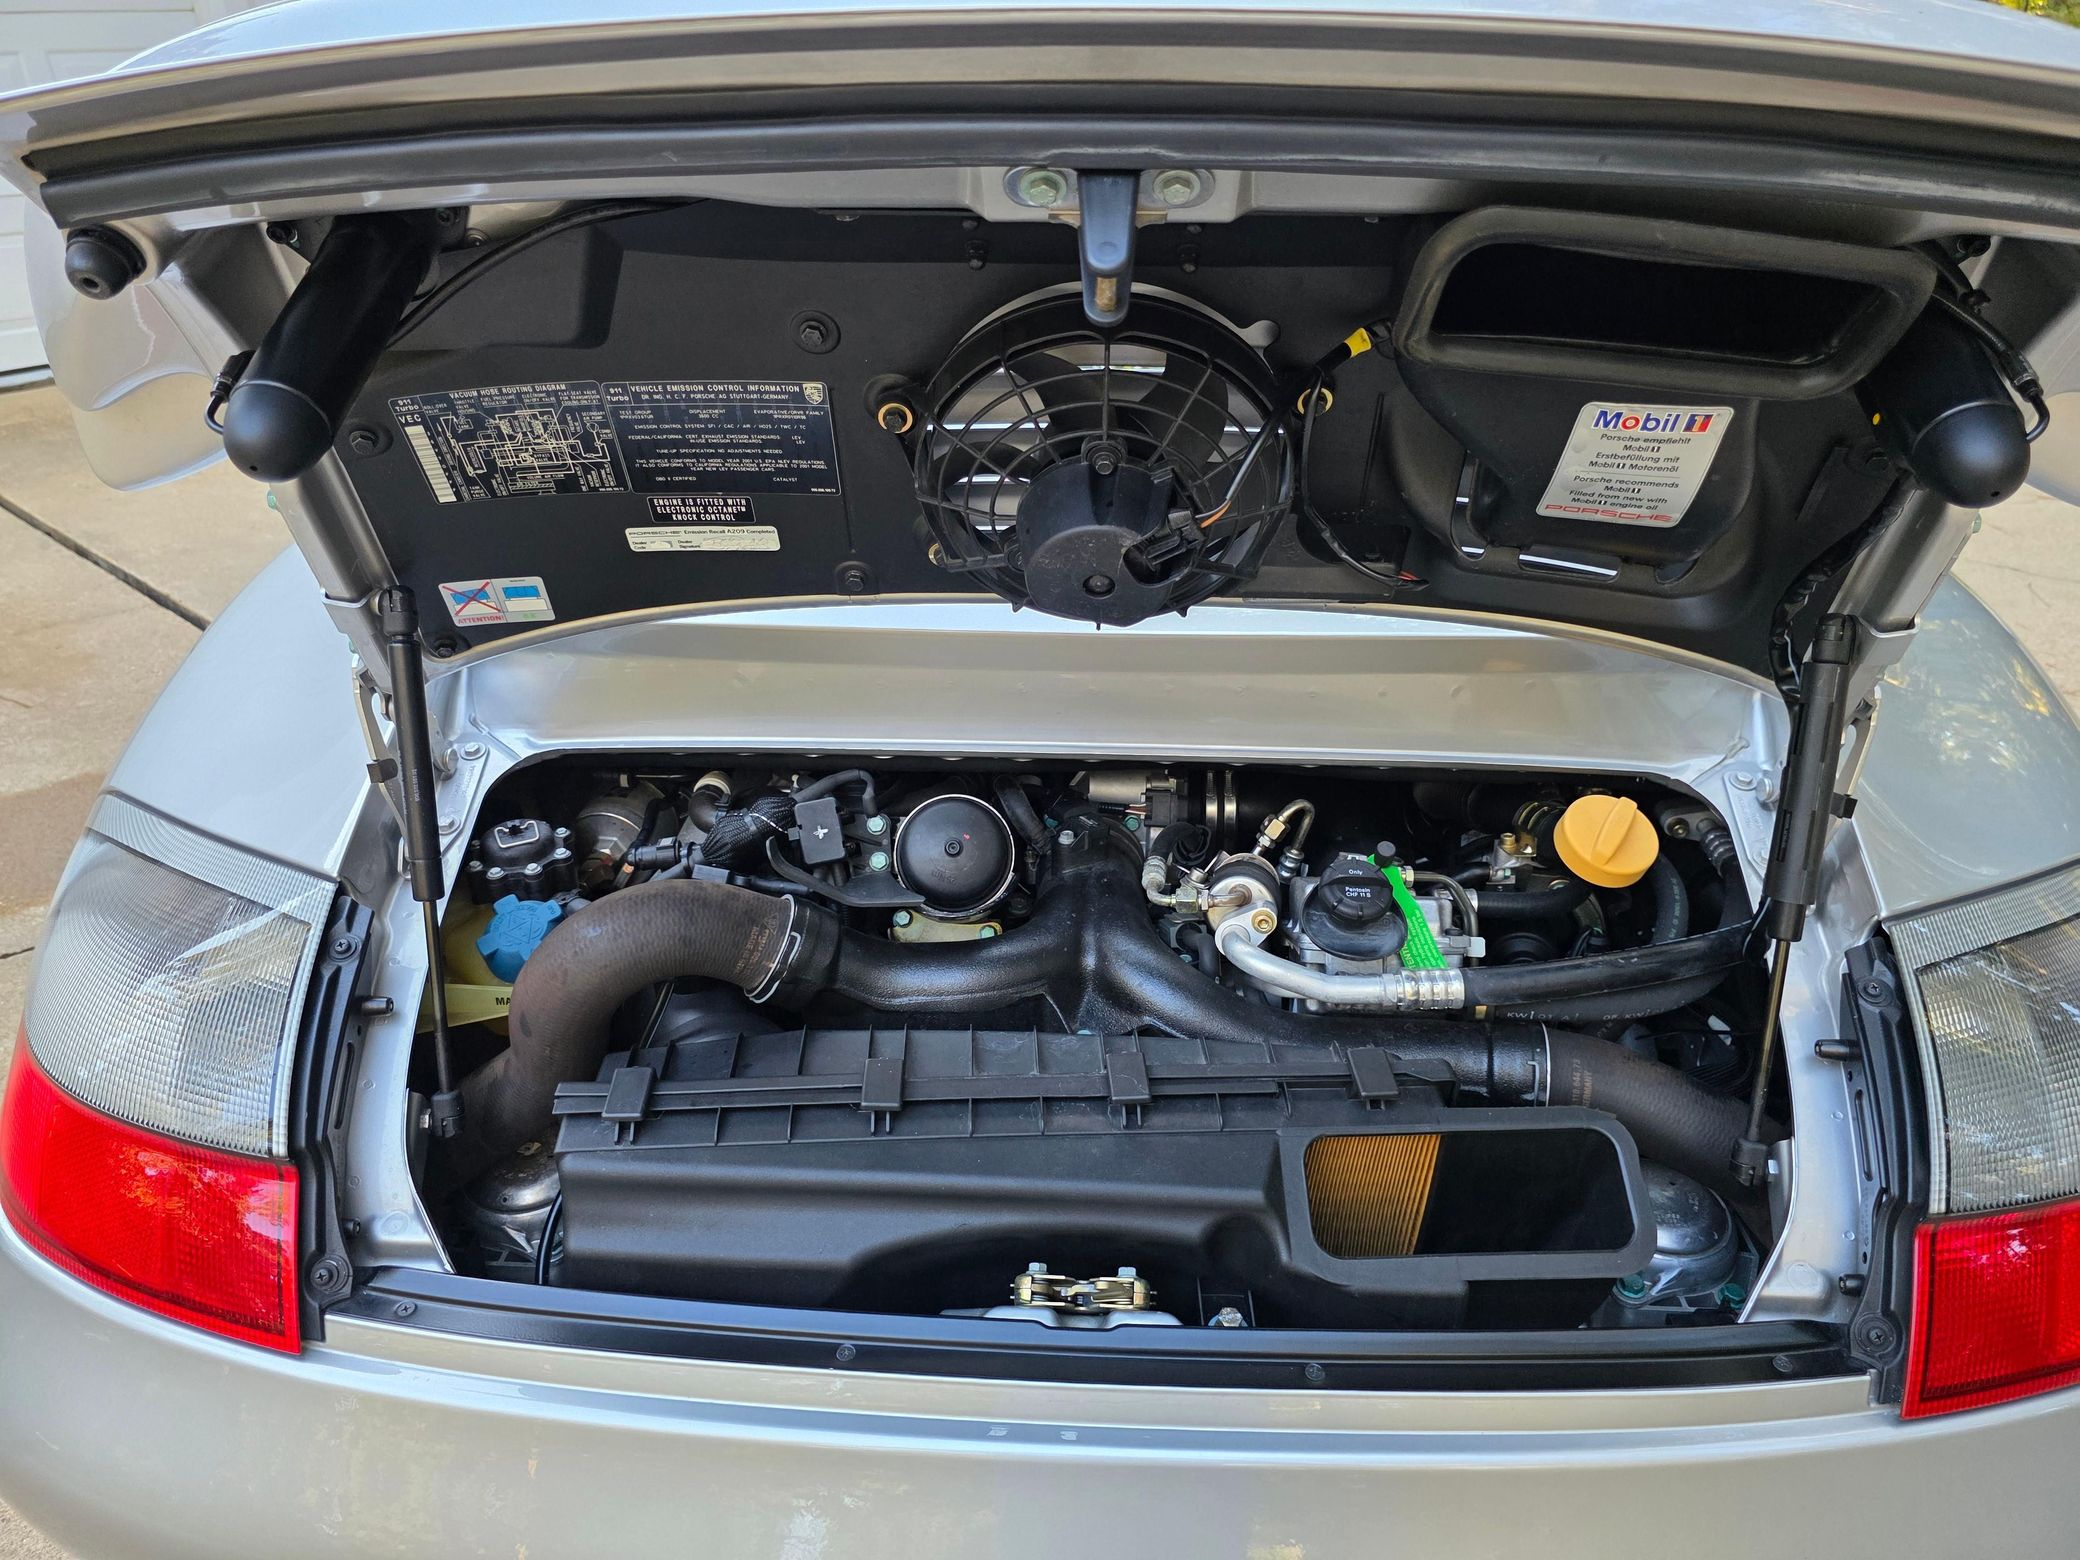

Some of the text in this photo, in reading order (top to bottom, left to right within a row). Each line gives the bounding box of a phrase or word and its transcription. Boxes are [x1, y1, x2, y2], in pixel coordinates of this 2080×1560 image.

[449, 384, 566, 399] VACUUM HOSE ROUTING DIAGRAM
[398, 414, 421, 424] VEC
[1592, 410, 1681, 432] Mobil
[1600, 433, 1691, 444] Porsche empfiehlt
[1596, 452, 1660, 463] Erstbefüllung
[1628, 463, 1679, 472] Motorenöl
[1573, 475, 1679, 488] Porsche recommends
[1545, 504, 1673, 522] PORSCHE
